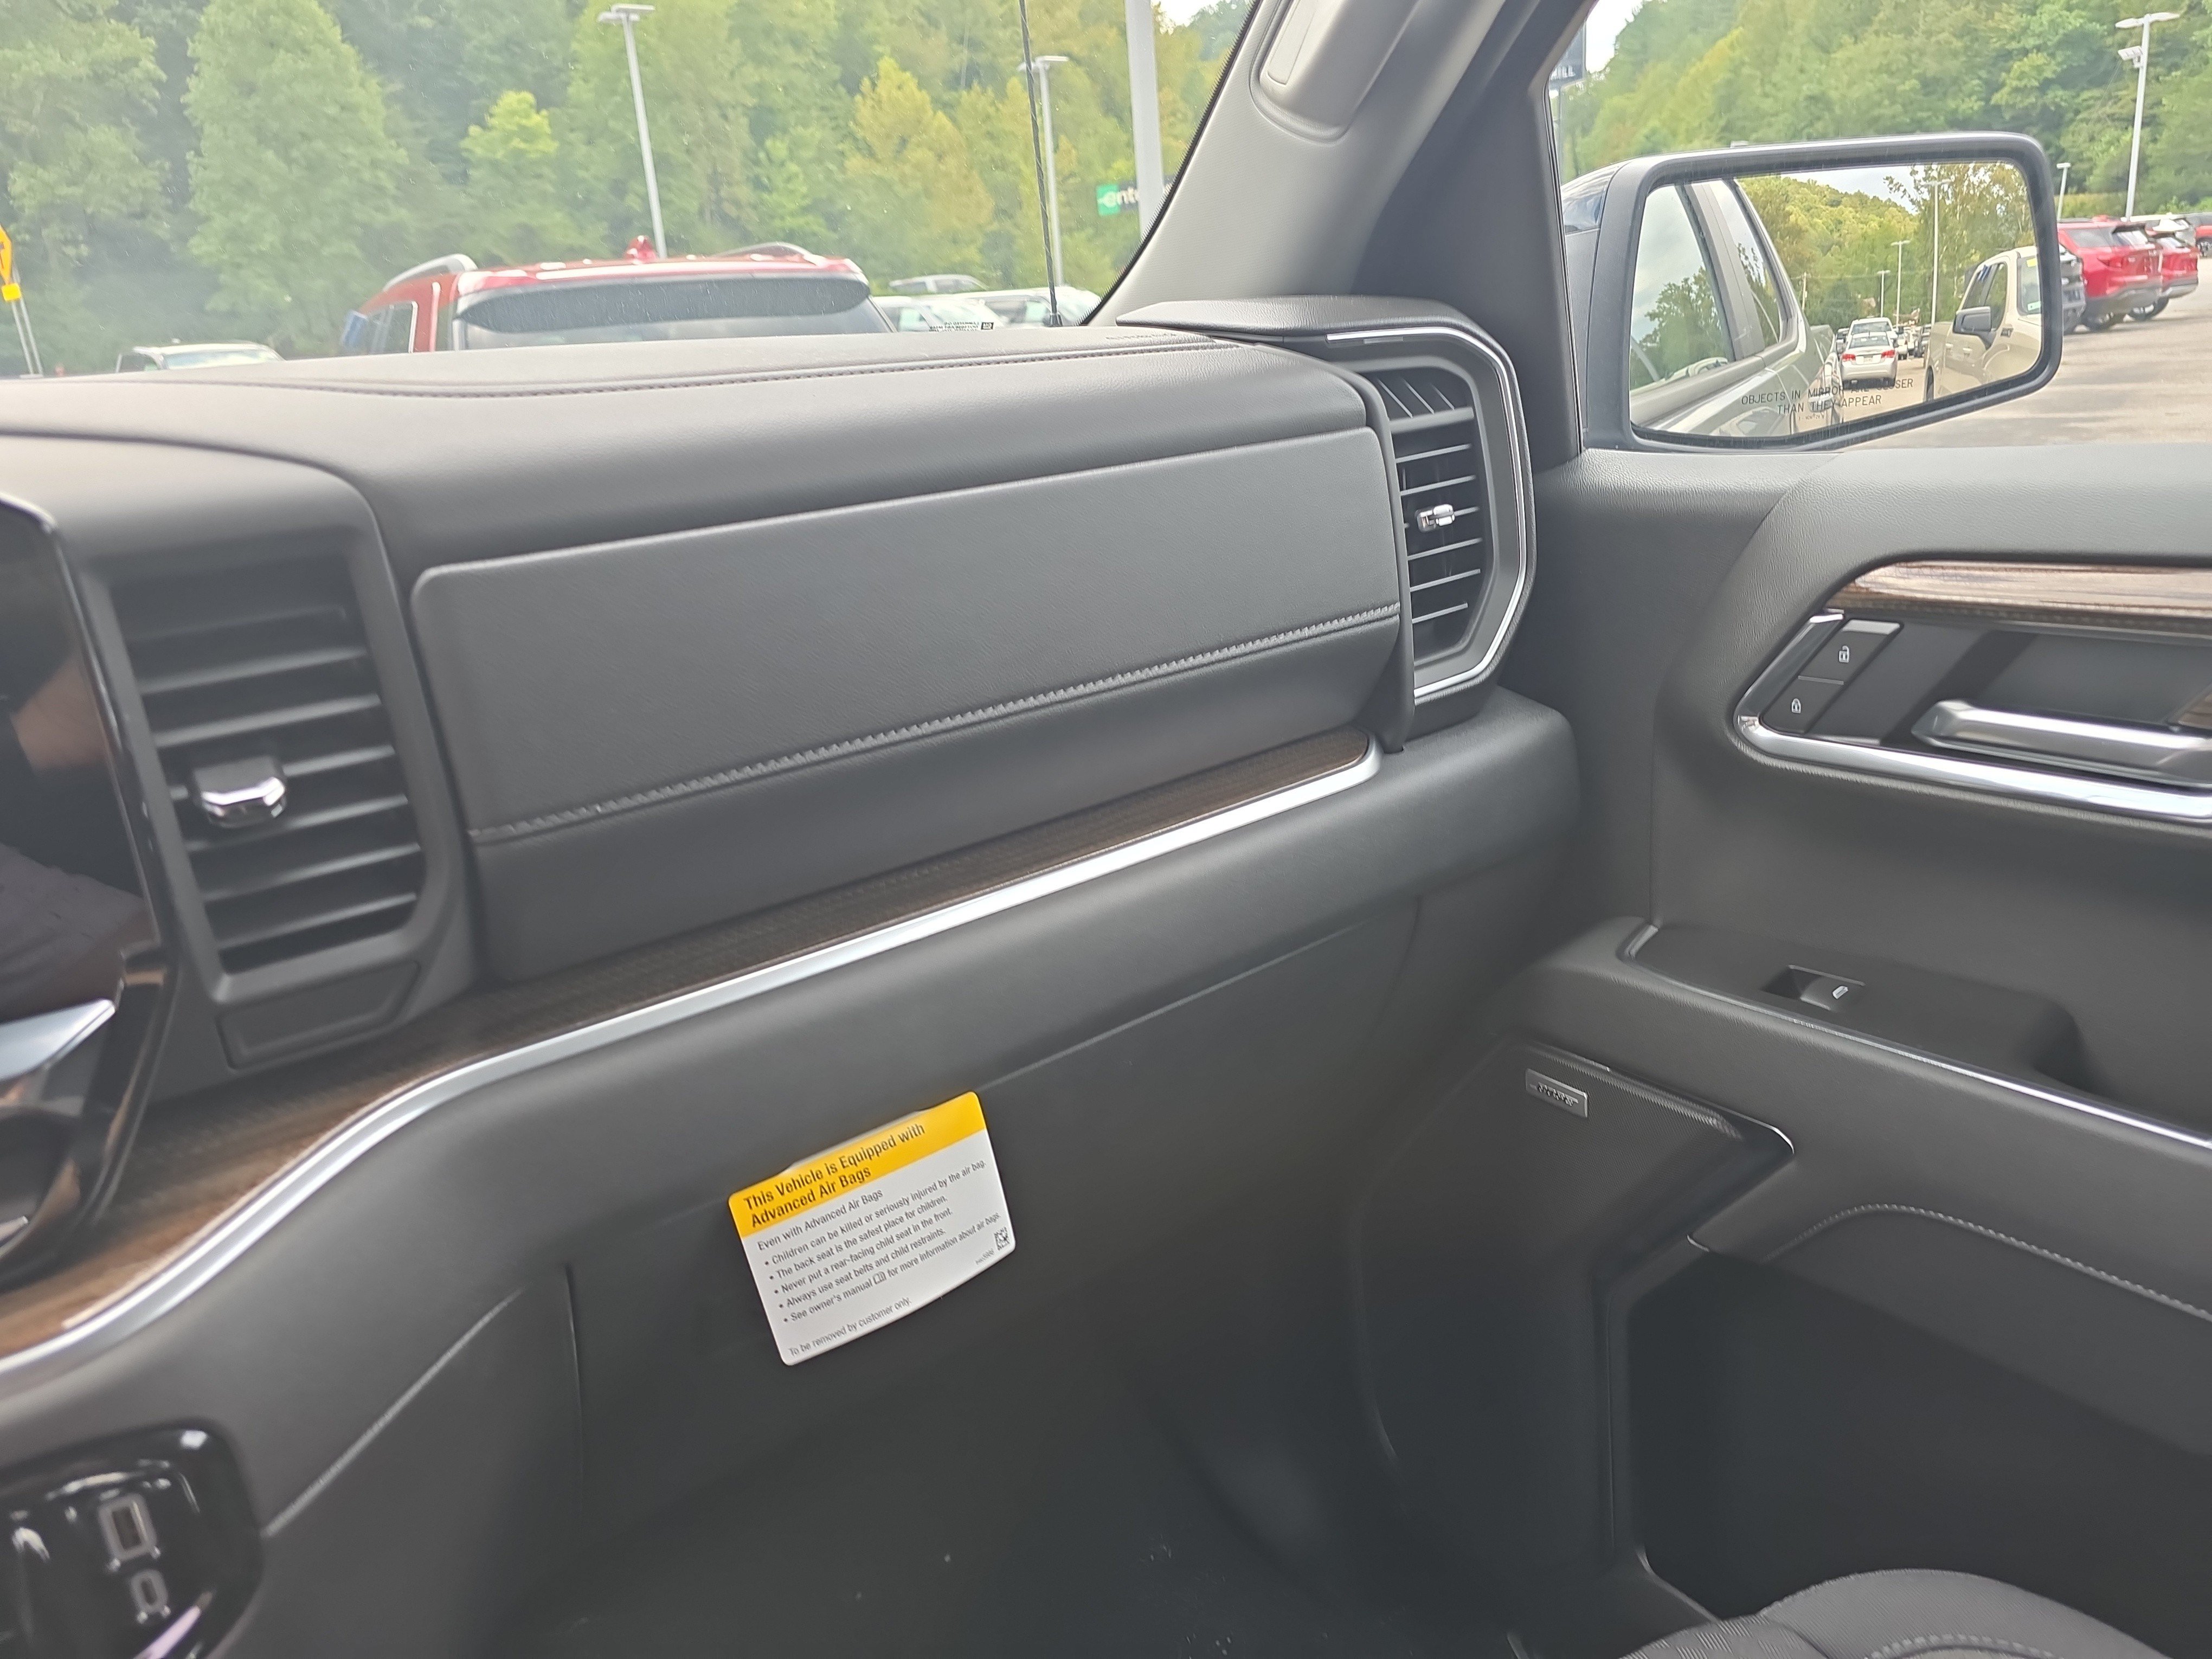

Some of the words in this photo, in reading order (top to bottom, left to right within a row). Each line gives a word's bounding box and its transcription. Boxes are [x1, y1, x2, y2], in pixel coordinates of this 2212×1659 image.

[1741, 391, 1786, 405] OBJECTS
[1792, 389, 1801, 400] IN
[1777, 403, 1804, 415] THAN
[1811, 400, 1836, 411] THEY
[1842, 395, 1881, 408] APPEAR
[743, 1191, 774, 1210] This
[775, 1169, 824, 1197] Vehicle
[824, 1162, 838, 1175] is
[839, 1135, 897, 1169] Equipped
[898, 1123, 925, 1142] with
[751, 1188, 816, 1227] Advanced
[819, 1181, 837, 1198] Air
[839, 1167, 871, 1188] Bags
[757, 1236, 781, 1251] Even
[782, 1225, 803, 1240] with
[805, 1204, 847, 1231] Advanced
[848, 1200, 860, 1212] Air
[860, 1189, 883, 1205] Bags
[771, 1243, 809, 1264] Children
[810, 1236, 827, 1248] can
[827, 1230, 839, 1240] be
[839, 1217, 864, 1235] killed
[864, 1213, 873, 1223] or
[874, 1196, 910, 1218] seriously
[910, 1182, 937, 1200] injured
[937, 1178, 948, 1188] by
[948, 1172, 961, 1182] the
[961, 1167, 971, 1176] air
[971, 1160, 987, 1171] bag.
[776, 1267, 793, 1279] The
[793, 1256, 816, 1271] back
[816, 1247, 835, 1262] seat
[835, 1244, 844, 1253] is
[844, 1237, 858, 1249] the
[858, 1224, 883, 1242] safest
[883, 1216, 905, 1232] place
[904, 1209, 916, 1220] for
[917, 1195, 948, 1214] children.
[781, 1277, 806, 1294] Never
[808, 1269, 822, 1283] put
[830, 1246, 876, 1271] rear-facing
[875, 1234, 895, 1250] child
[895, 1226, 912, 1241] seat
[912, 1224, 921, 1233] in
[921, 1217, 933, 1229] the
[934, 1207, 954, 1222] front.
[787, 1289, 817, 1308] Always
[818, 1282, 834, 1294] use
[834, 1271, 853, 1286] seat
[853, 1263, 874, 1277] belts
[874, 1253, 891, 1267] and
[891, 1244, 910, 1259] child
[910, 1227, 946, 1251] restraints.
[790, 1309, 808, 1321] See
[809, 1294, 843, 1314] owner's
[843, 1278, 873, 1299] manual
[887, 1266, 898, 1278] for
[899, 1257, 919, 1272] more
[919, 1237, 958, 1262] information
[958, 1225, 976, 1241] about
[976, 1220, 985, 1231] air
[788, 1346, 799, 1356] To
[799, 1343, 811, 1353] be
[812, 1326, 847, 1347] removed
[847, 1322, 857, 1332] by
[858, 1306, 893, 1327] customer
